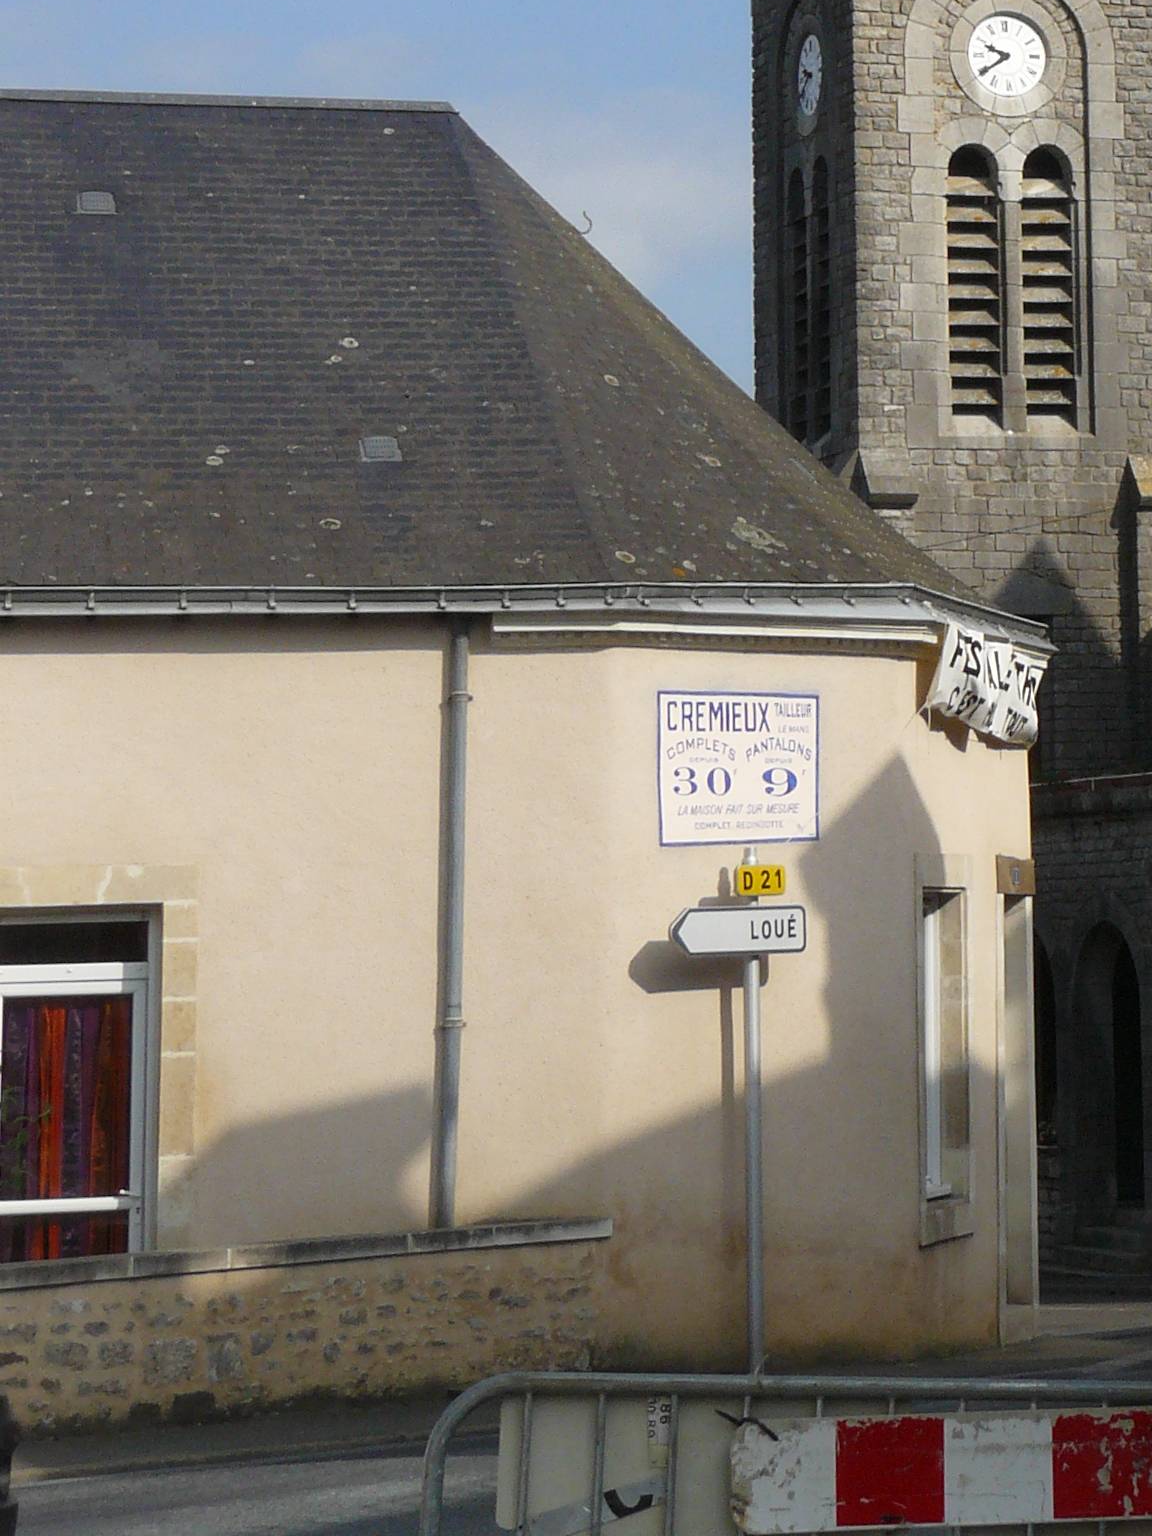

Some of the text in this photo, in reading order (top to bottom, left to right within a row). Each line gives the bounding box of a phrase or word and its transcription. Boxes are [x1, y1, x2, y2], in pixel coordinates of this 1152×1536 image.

[667, 701, 812, 732] CREMIEUX TAILLEUR
[666, 737, 736, 761] COMPLETS
[745, 736, 812, 762] PANTALONS
[677, 802, 800, 816] LA MAISON FAIT SUR MESURE
[743, 869, 782, 890] D 21
[751, 914, 797, 940] LOUÉ
